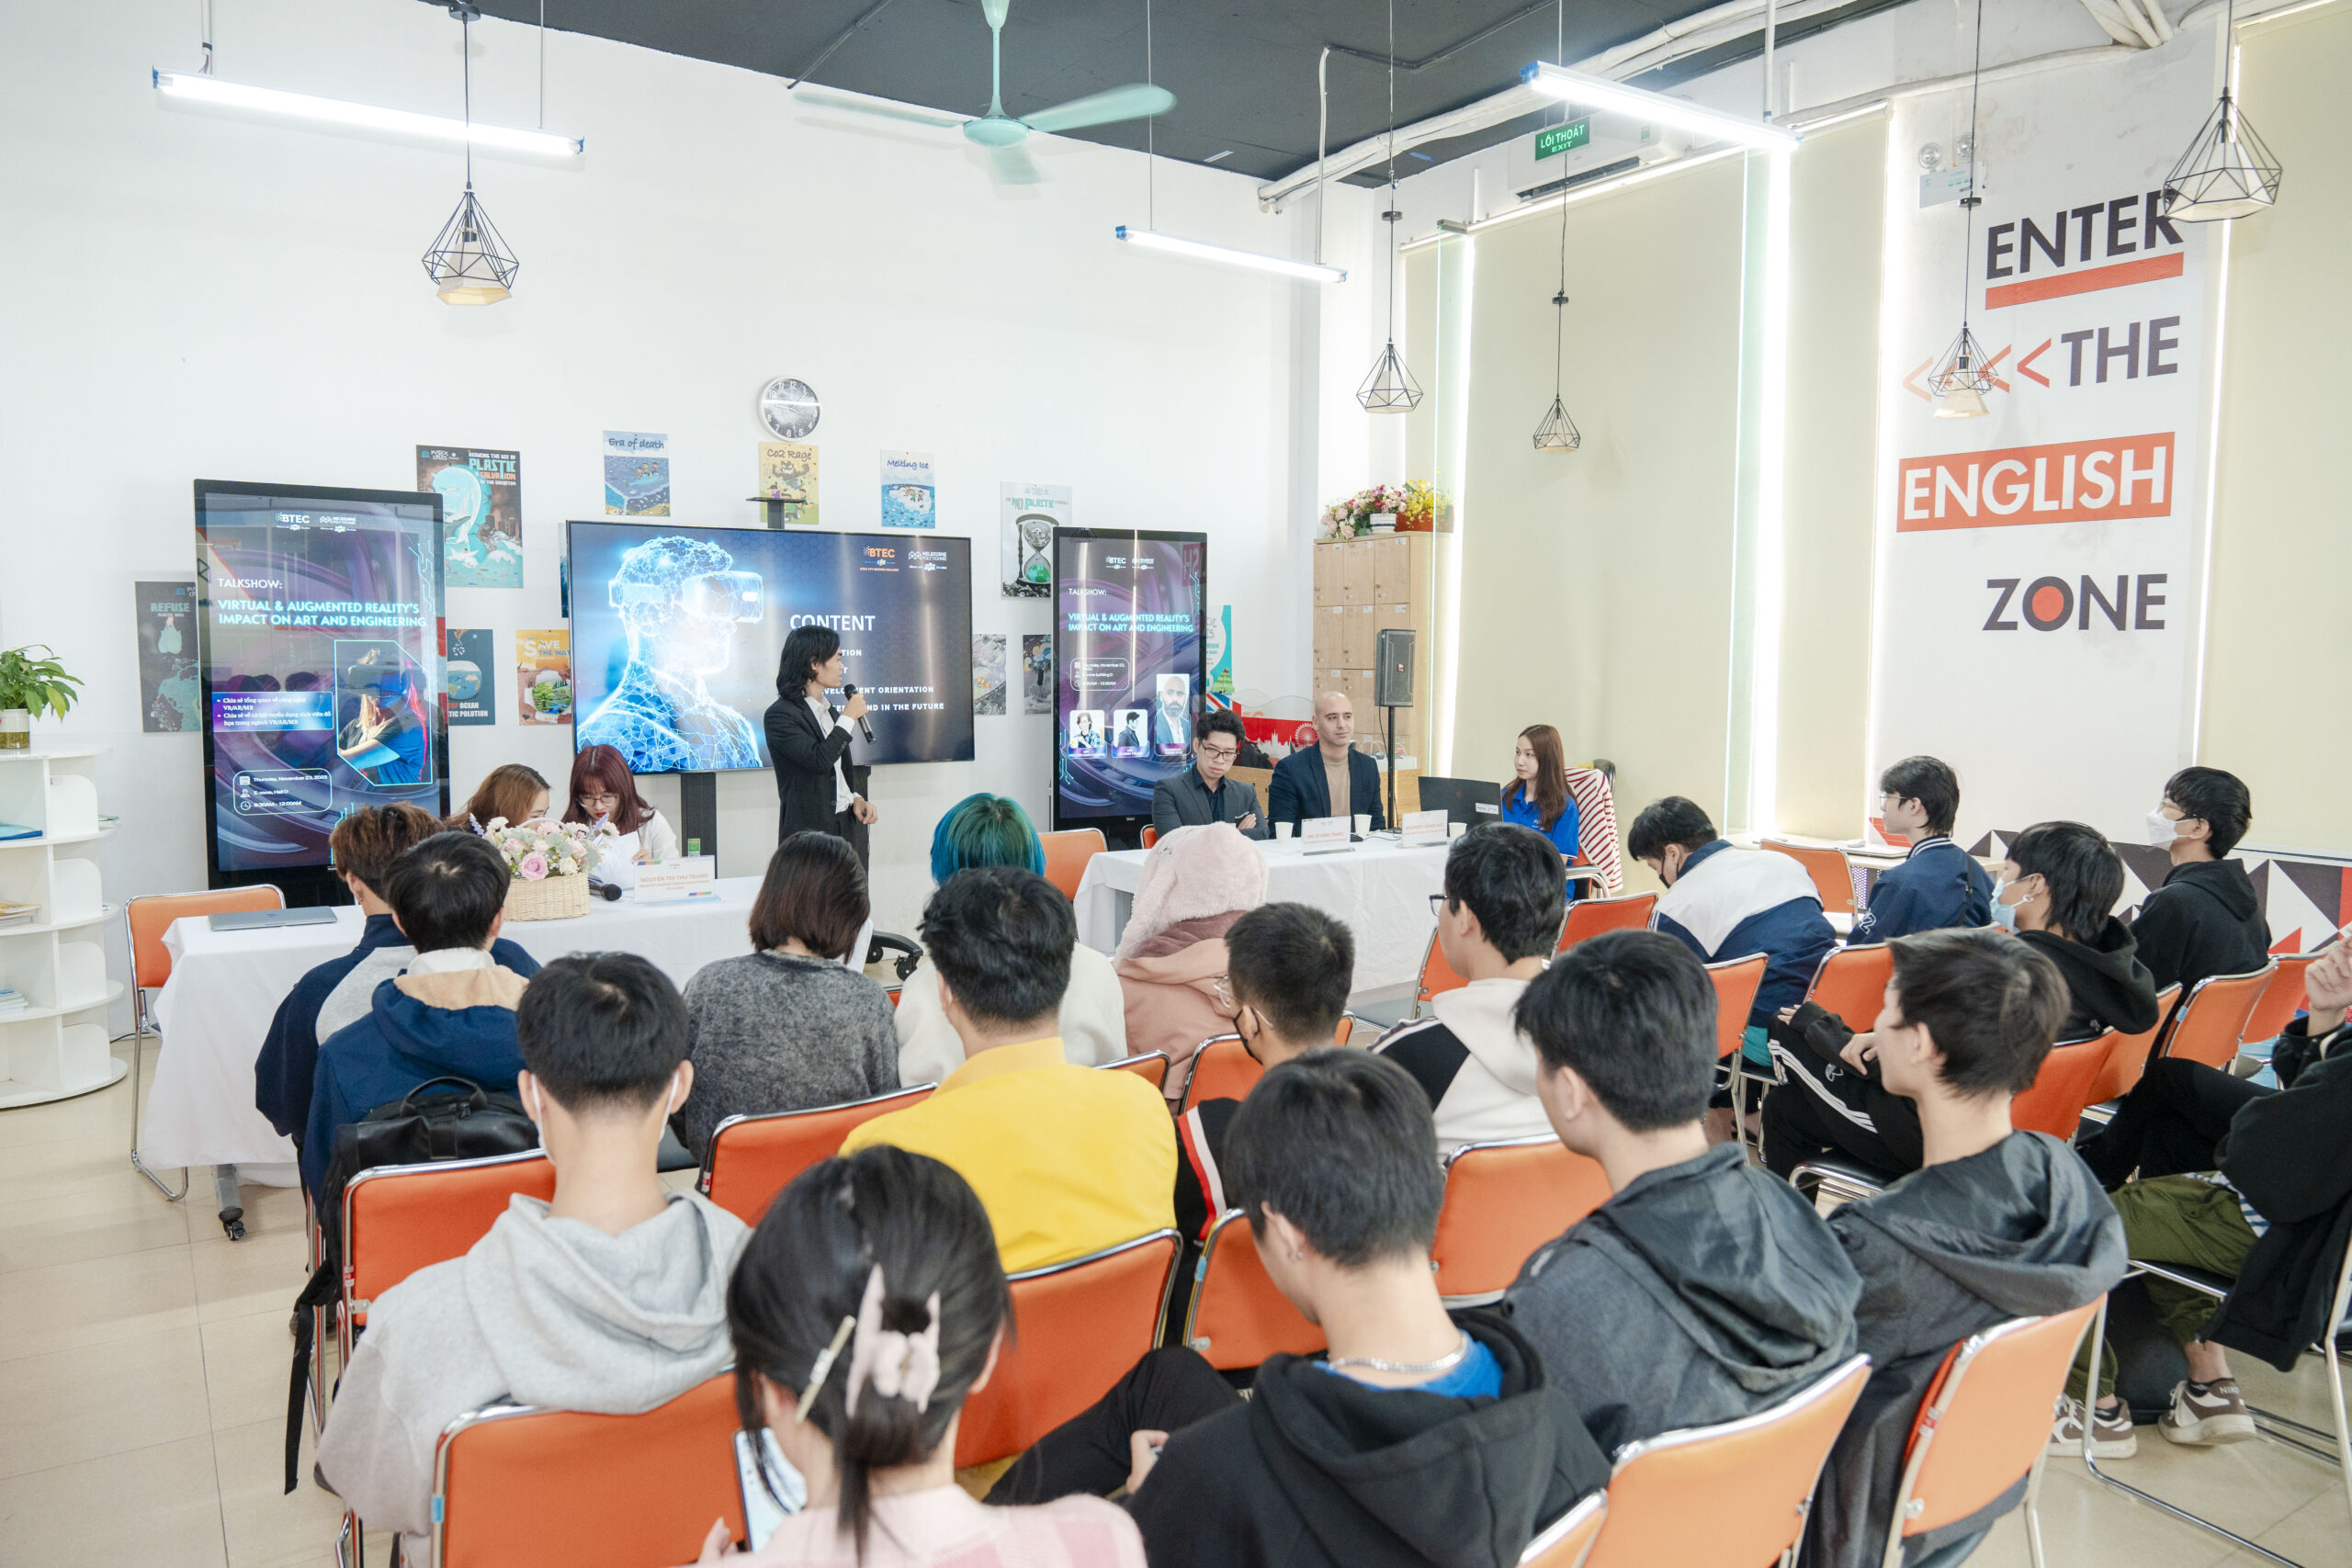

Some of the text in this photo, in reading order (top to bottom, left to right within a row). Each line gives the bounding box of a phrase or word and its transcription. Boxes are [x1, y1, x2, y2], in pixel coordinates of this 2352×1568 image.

[1555, 124, 1585, 143] THOÁT
[1552, 141, 1572, 152] EXIT
[1985, 189, 2184, 279] ENTER
[2061, 316, 2180, 387] THE
[608, 438, 664, 450] Era of death
[787, 450, 812, 462] Rage
[469, 457, 516, 479] PLASTIC
[887, 459, 929, 470] Melting Ice
[1903, 446, 2167, 521] ENGLISH
[281, 514, 311, 524] BTEC
[869, 547, 895, 558] BTEC
[218, 578, 283, 589] TALKSHOW:
[150, 602, 190, 613] REFUSE
[217, 599, 420, 614] VIRTUAL & AUGMENTED REALITY'S
[1982, 573, 2168, 632] ZONE
[218, 613, 426, 627] IMPACT ON ART AND ENGINEERING
[790, 614, 876, 631] CONTENT
[1068, 613, 1100, 622] VIRTUAL
[524, 640, 560, 657] SAVE
